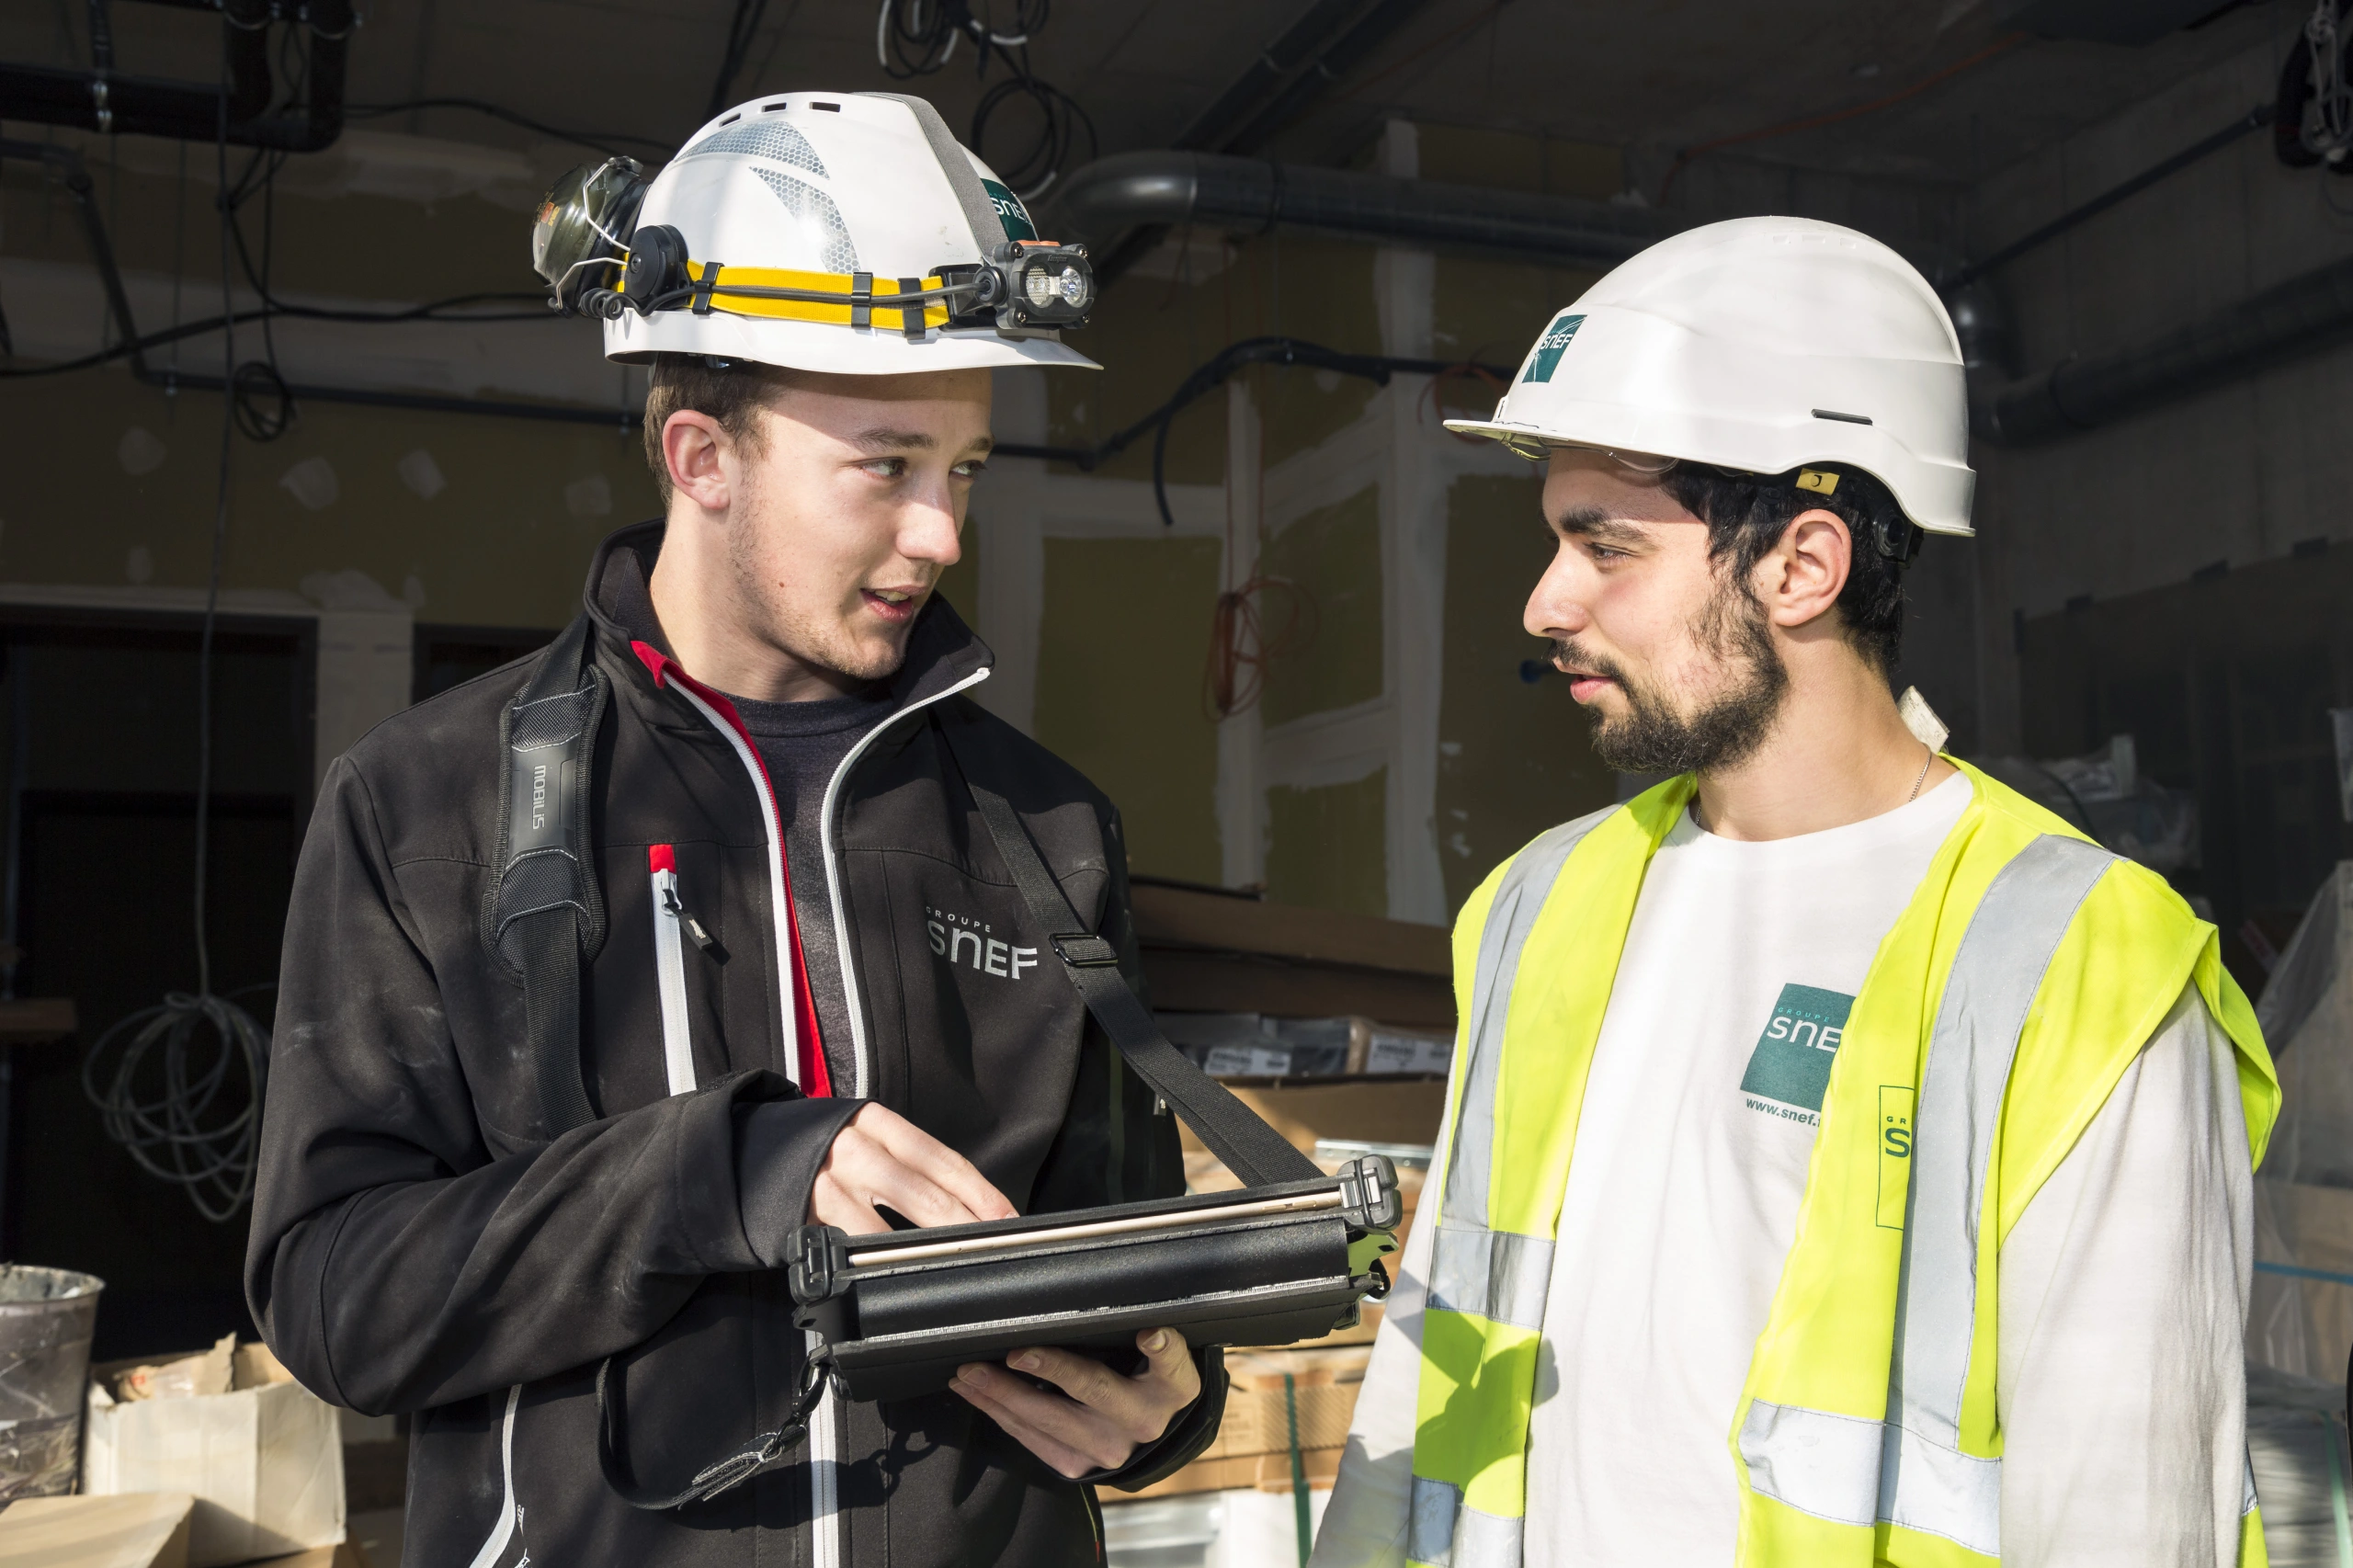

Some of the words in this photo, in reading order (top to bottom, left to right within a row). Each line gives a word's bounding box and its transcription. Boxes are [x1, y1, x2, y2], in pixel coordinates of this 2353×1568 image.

[926, 906, 991, 933] GROUPE
[1778, 1006, 1830, 1023] GROUPE
[1767, 1016, 1843, 1052] SNE
